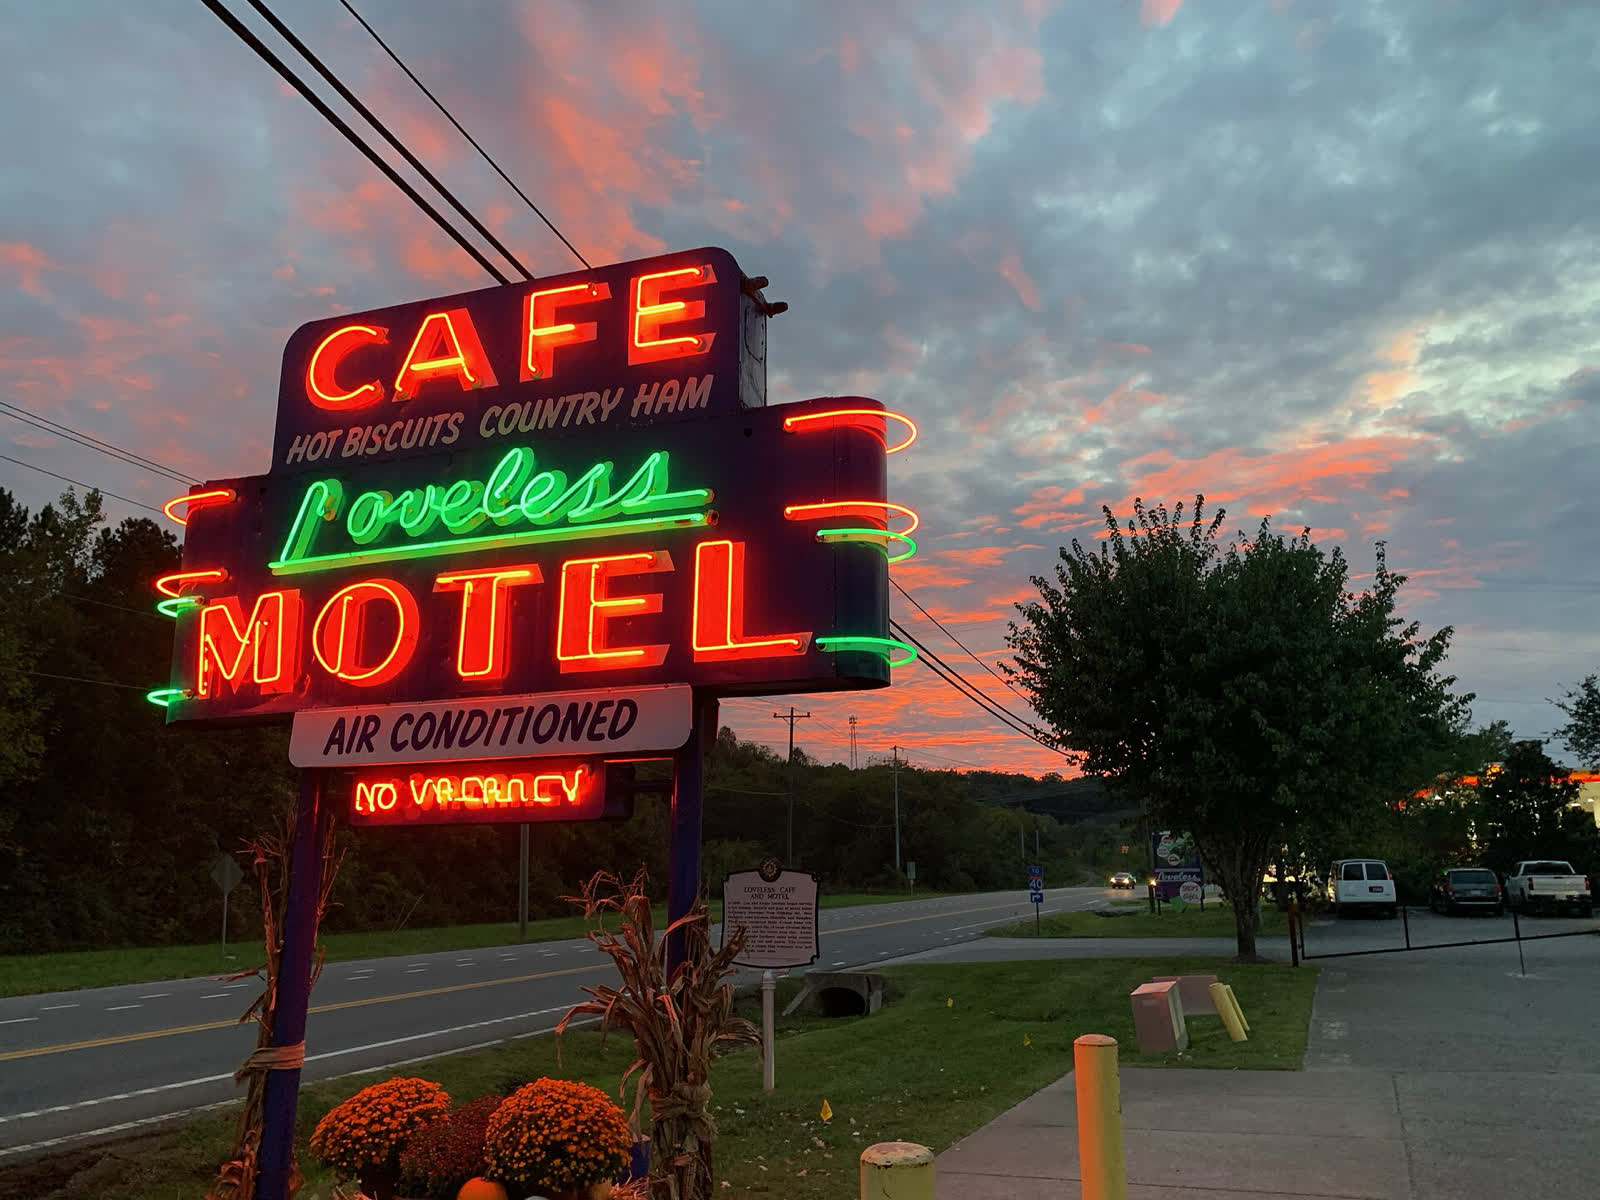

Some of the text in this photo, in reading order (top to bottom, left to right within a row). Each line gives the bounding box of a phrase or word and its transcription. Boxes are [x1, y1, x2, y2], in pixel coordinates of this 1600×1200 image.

[305, 264, 717, 412] CAFE
[287, 374, 716, 465] HOT BISCUITS COUNTRY HAM
[274, 447, 713, 568] Loveless
[196, 540, 813, 700] MOTEL
[322, 698, 639, 756] AIR CONDITIONED
[354, 781, 399, 813] NO
[1030, 878, 1043, 889] 40
